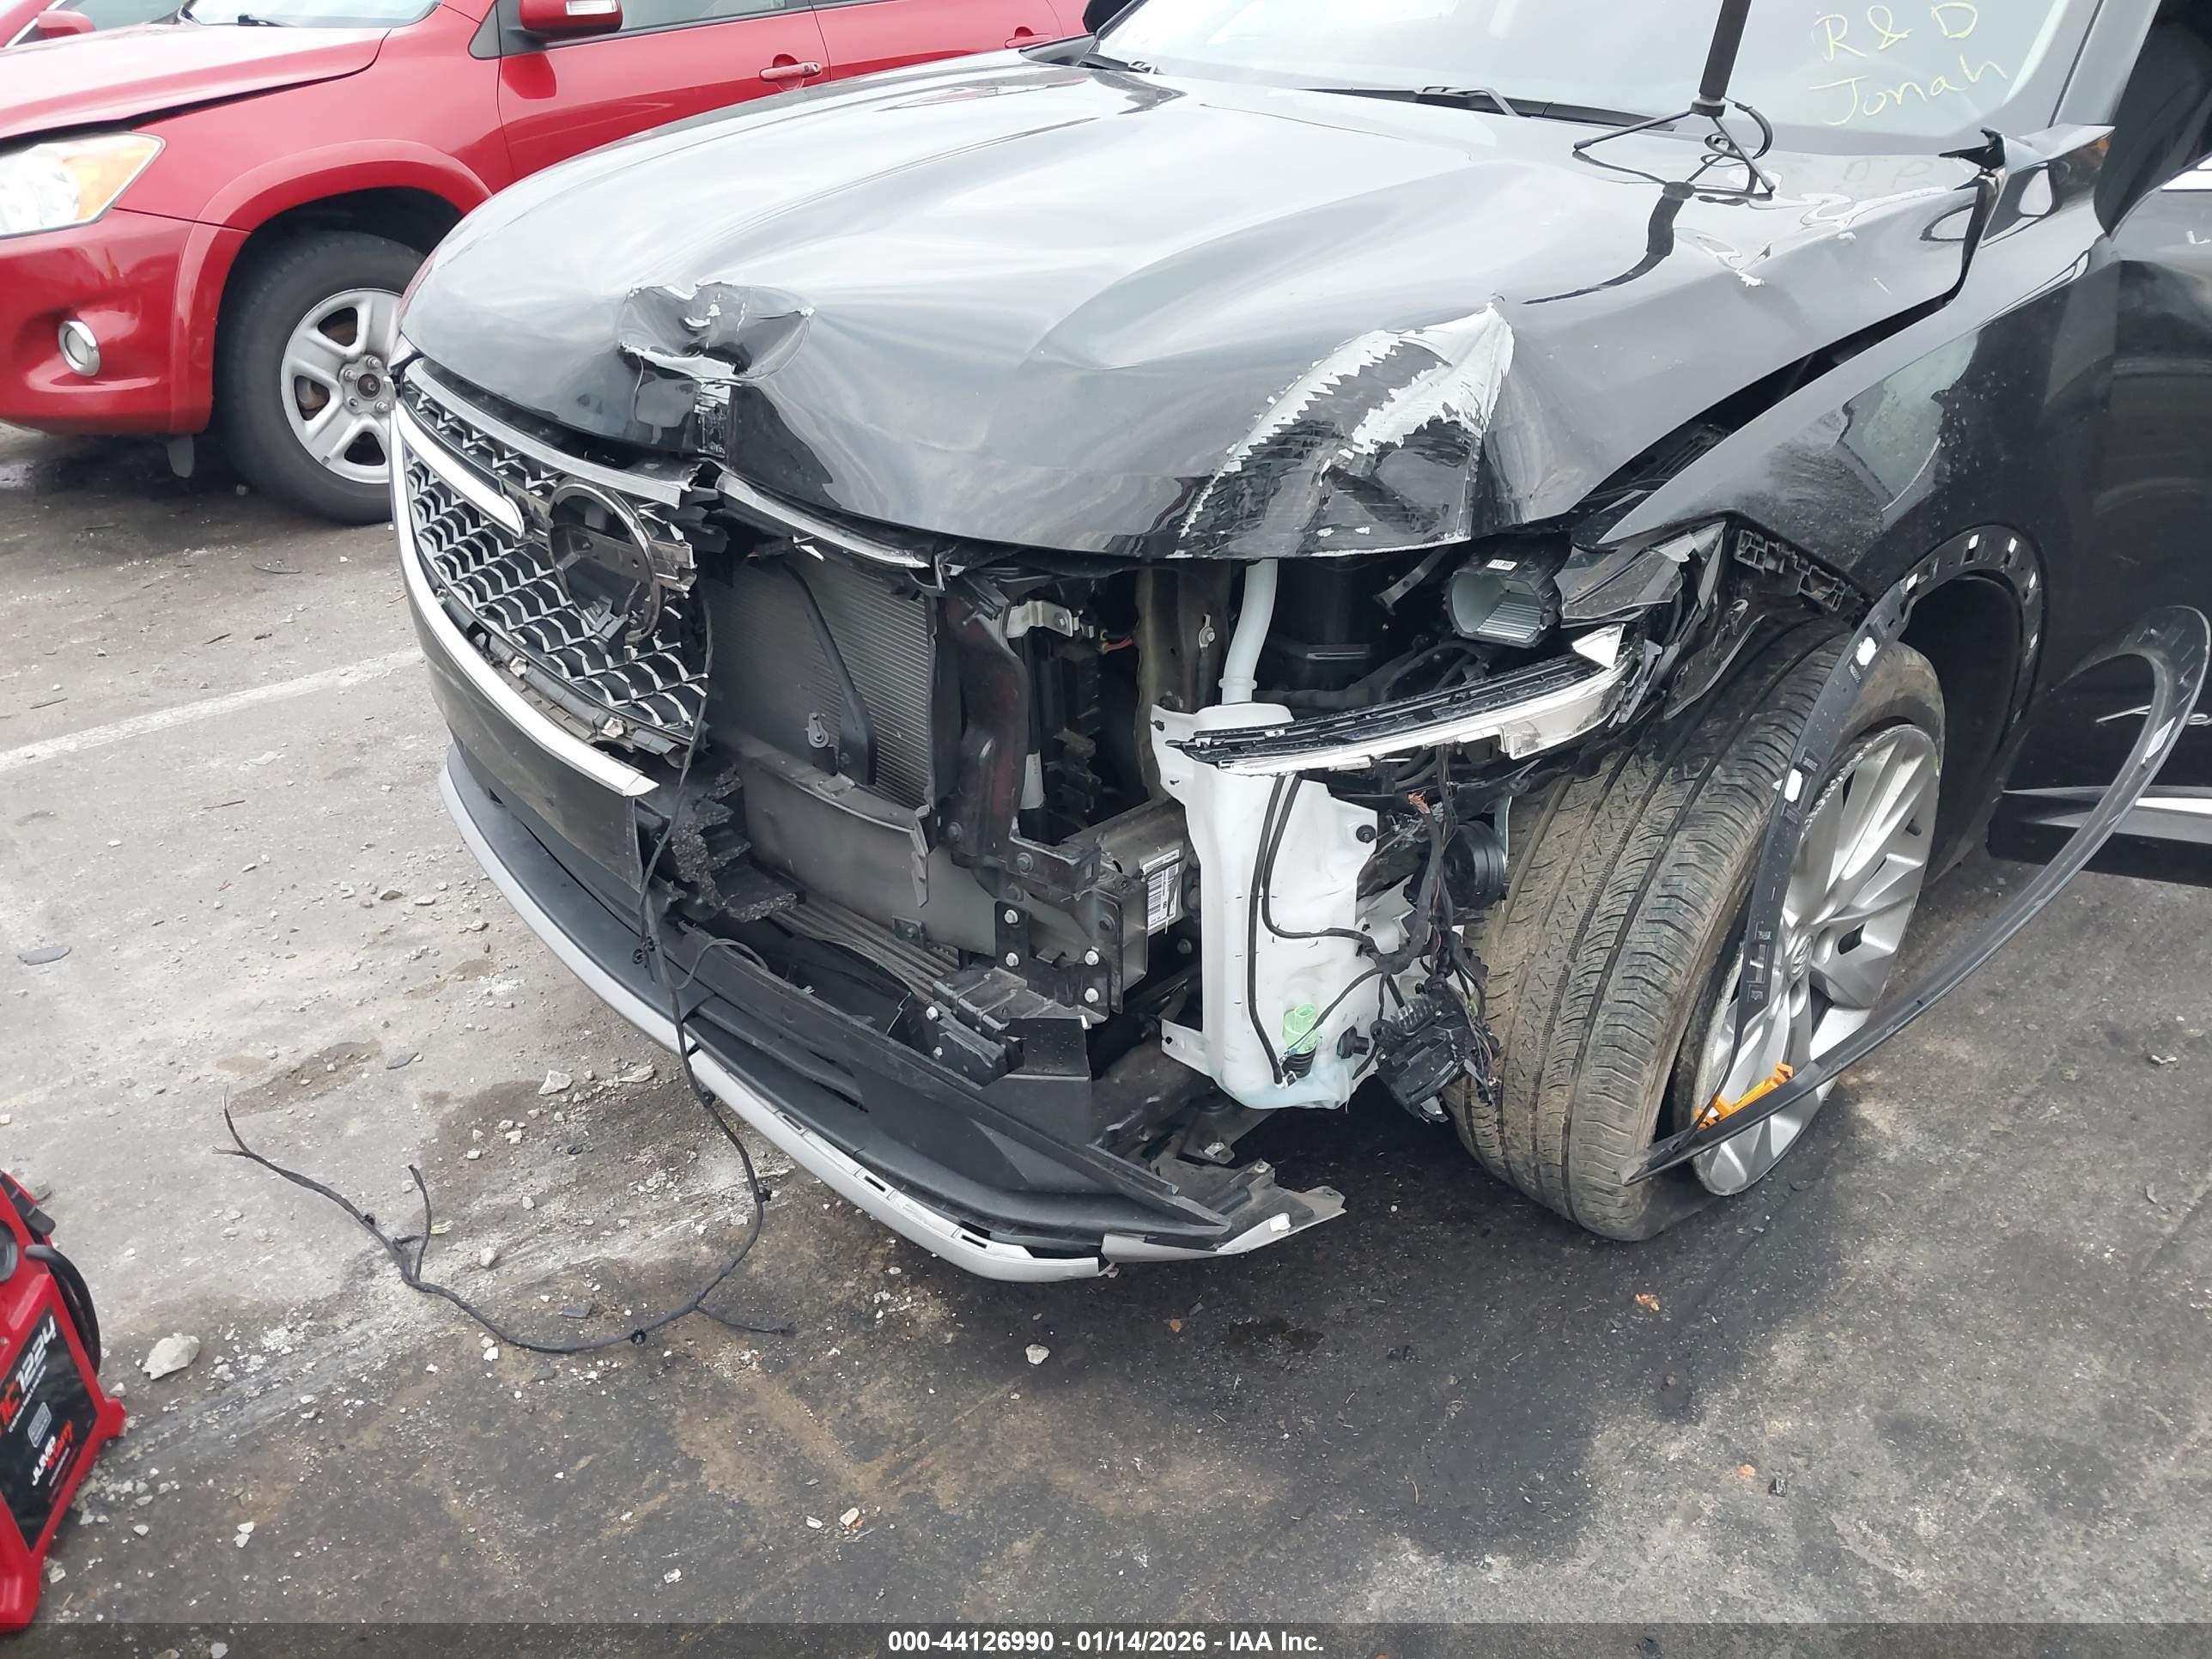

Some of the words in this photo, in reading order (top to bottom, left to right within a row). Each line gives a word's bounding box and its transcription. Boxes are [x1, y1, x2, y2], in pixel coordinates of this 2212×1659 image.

[1811, 14, 1869, 62] R
[1868, 5, 1914, 51] &
[1930, 2, 1978, 39] D
[1808, 55, 2008, 125] Jonah
